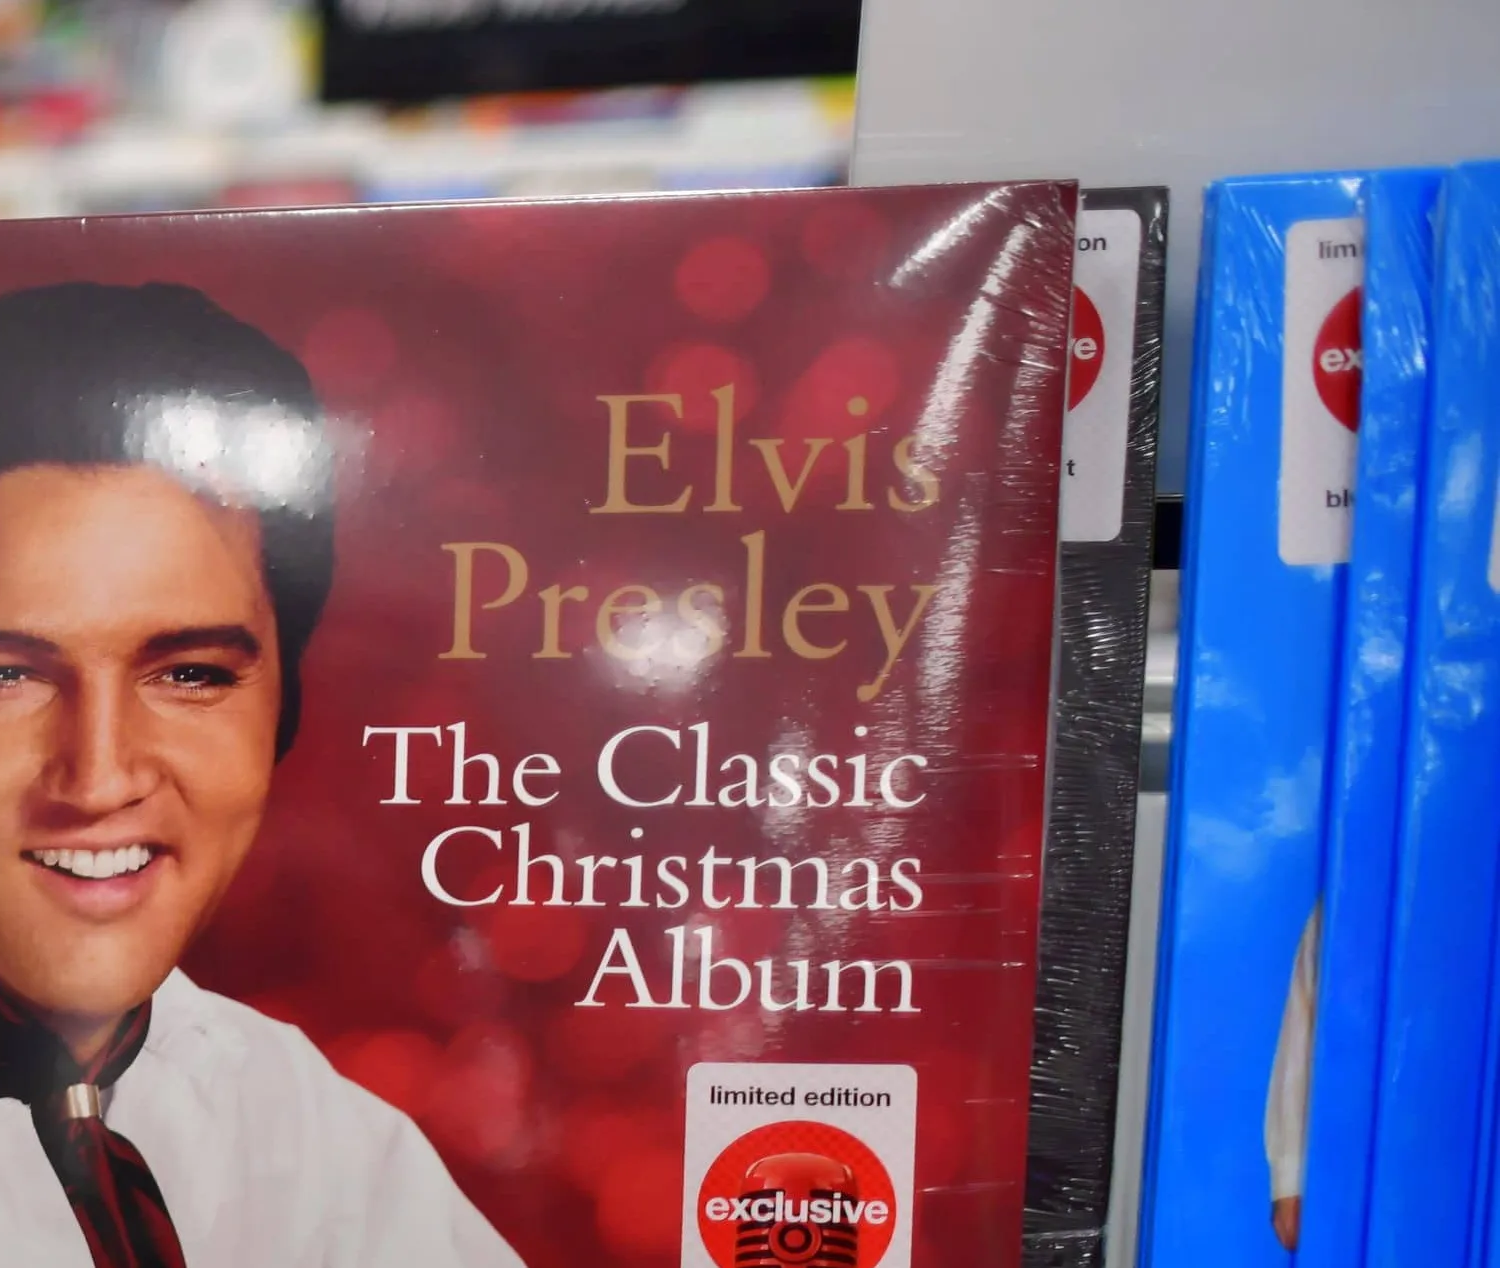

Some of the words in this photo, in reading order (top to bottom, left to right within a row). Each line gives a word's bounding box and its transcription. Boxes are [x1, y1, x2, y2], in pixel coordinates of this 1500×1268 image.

[1072, 337, 1097, 360] e
[589, 383, 941, 514] Elvis
[1326, 489, 1354, 508] bl
[438, 530, 938, 702] Presley
[363, 722, 561, 808] The
[598, 721, 927, 810] Classic
[421, 822, 923, 911] Christmas
[574, 925, 922, 1013] Album
[710, 1085, 795, 1107] limited
[804, 1087, 891, 1108] edition
[705, 1191, 889, 1226] exclusive
